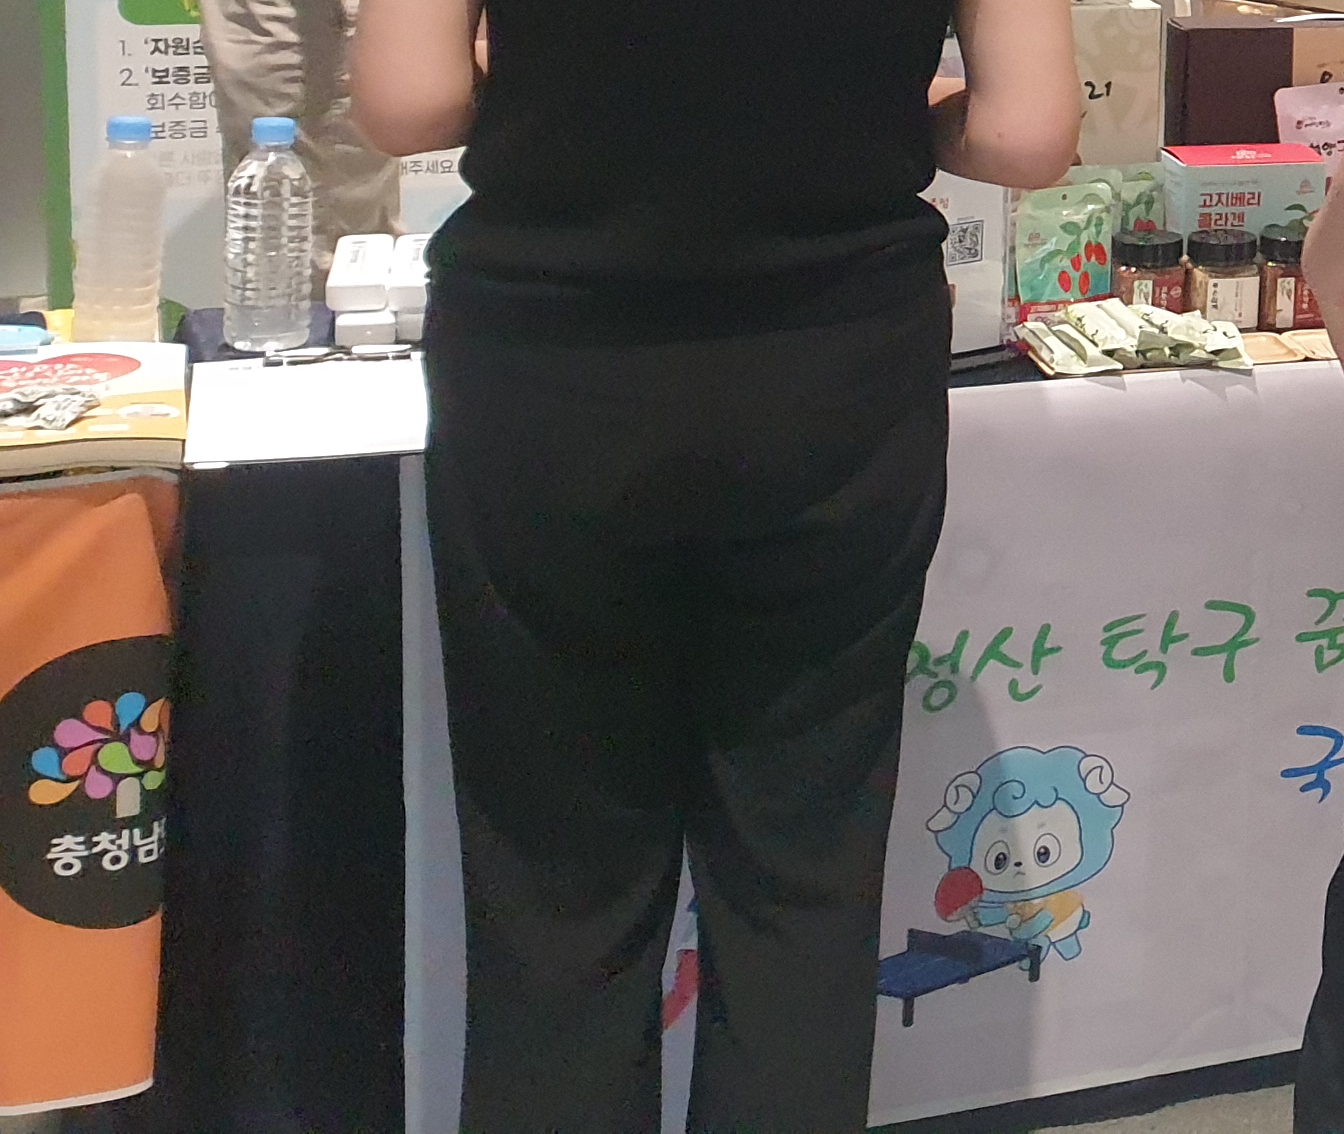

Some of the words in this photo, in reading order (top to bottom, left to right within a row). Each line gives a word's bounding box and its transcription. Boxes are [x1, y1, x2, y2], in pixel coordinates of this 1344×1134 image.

[119, 39, 132, 56] 1.
[1199, 192, 1261, 208] 고지베리
[1100, 599, 1260, 690] 탁구
[46, 817, 166, 876] 충청남
